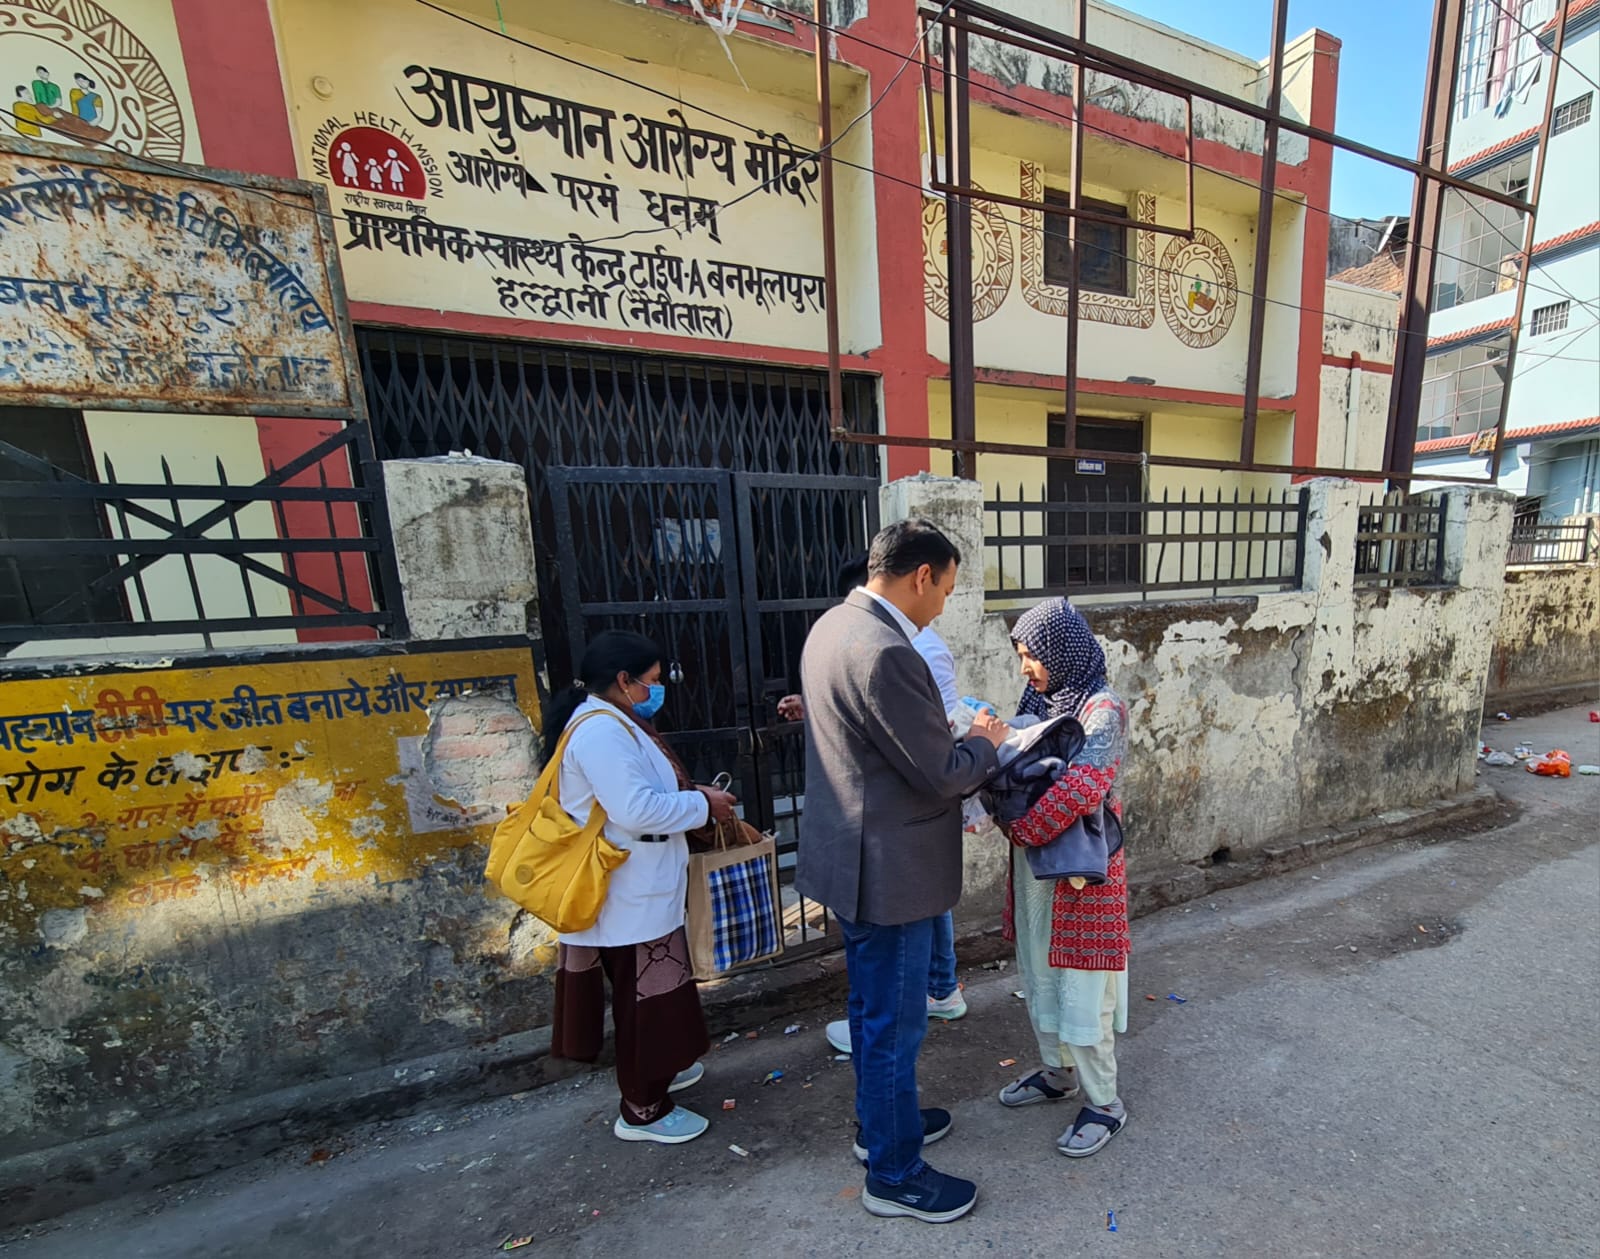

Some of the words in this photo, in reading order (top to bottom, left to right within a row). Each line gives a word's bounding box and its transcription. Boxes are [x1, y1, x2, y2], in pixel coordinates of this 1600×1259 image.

[312, 117, 350, 179] NATIONAL
[395, 65, 617, 164] आयुष्मान
[620, 108, 736, 186] आरोग्य
[744, 129, 820, 207] मंदिर
[551, 172, 619, 223] परमं
[341, 208, 474, 264] प्राथमिक
[473, 230, 565, 278] स्वास्थ्य
[568, 233, 626, 290] केन्द्र
[220, 685, 284, 730] जीत
[286, 678, 370, 723] बनाये
[3, 760, 85, 804] रोग
[97, 751, 139, 791] के
